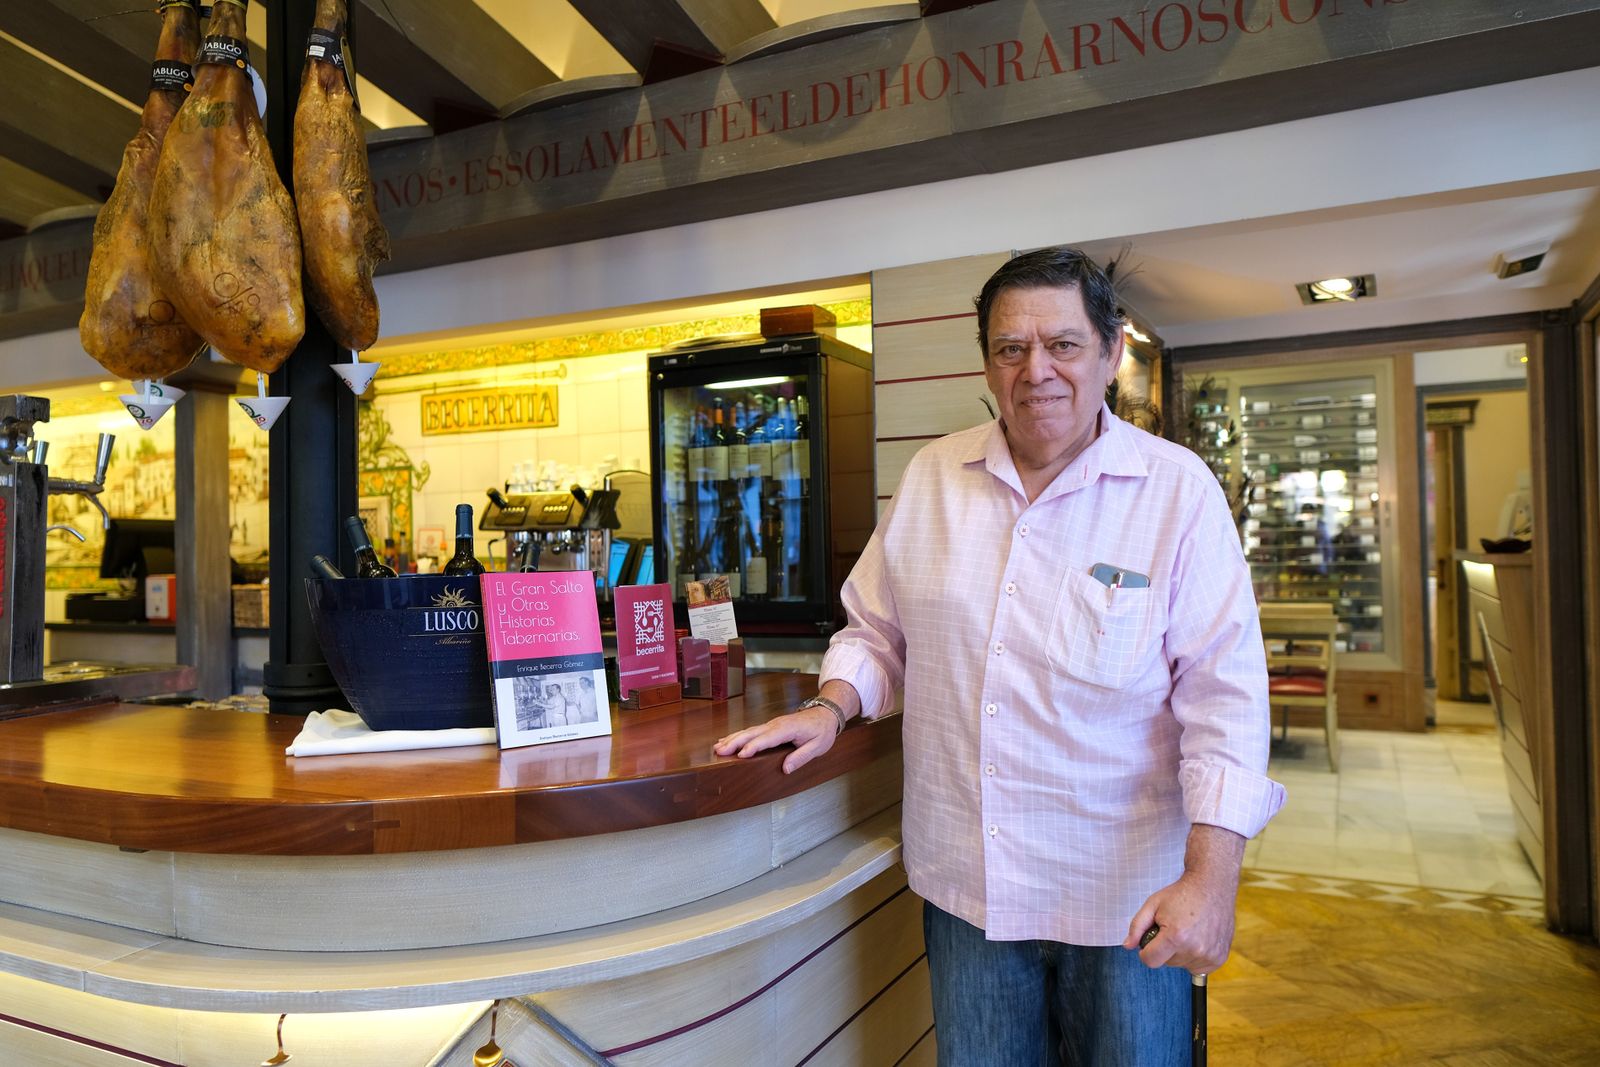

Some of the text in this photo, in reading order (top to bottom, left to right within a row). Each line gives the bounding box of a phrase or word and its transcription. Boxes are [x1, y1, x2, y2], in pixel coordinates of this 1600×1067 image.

[204, 41, 242, 55] JABUGO
[153, 67, 189, 79] JABUGO
[426, 391, 556, 431] BECERRITA
[495, 580, 584, 597] El Gran Salto
[497, 597, 549, 615] y Otras
[424, 609, 479, 632] LUSCO
[500, 614, 556, 630] Historias
[501, 629, 581, 646] Tabernarias.
[635, 644, 665, 656] becerrita
[516, 664, 539, 673] Enrique
[540, 662, 563, 671] Becerra
